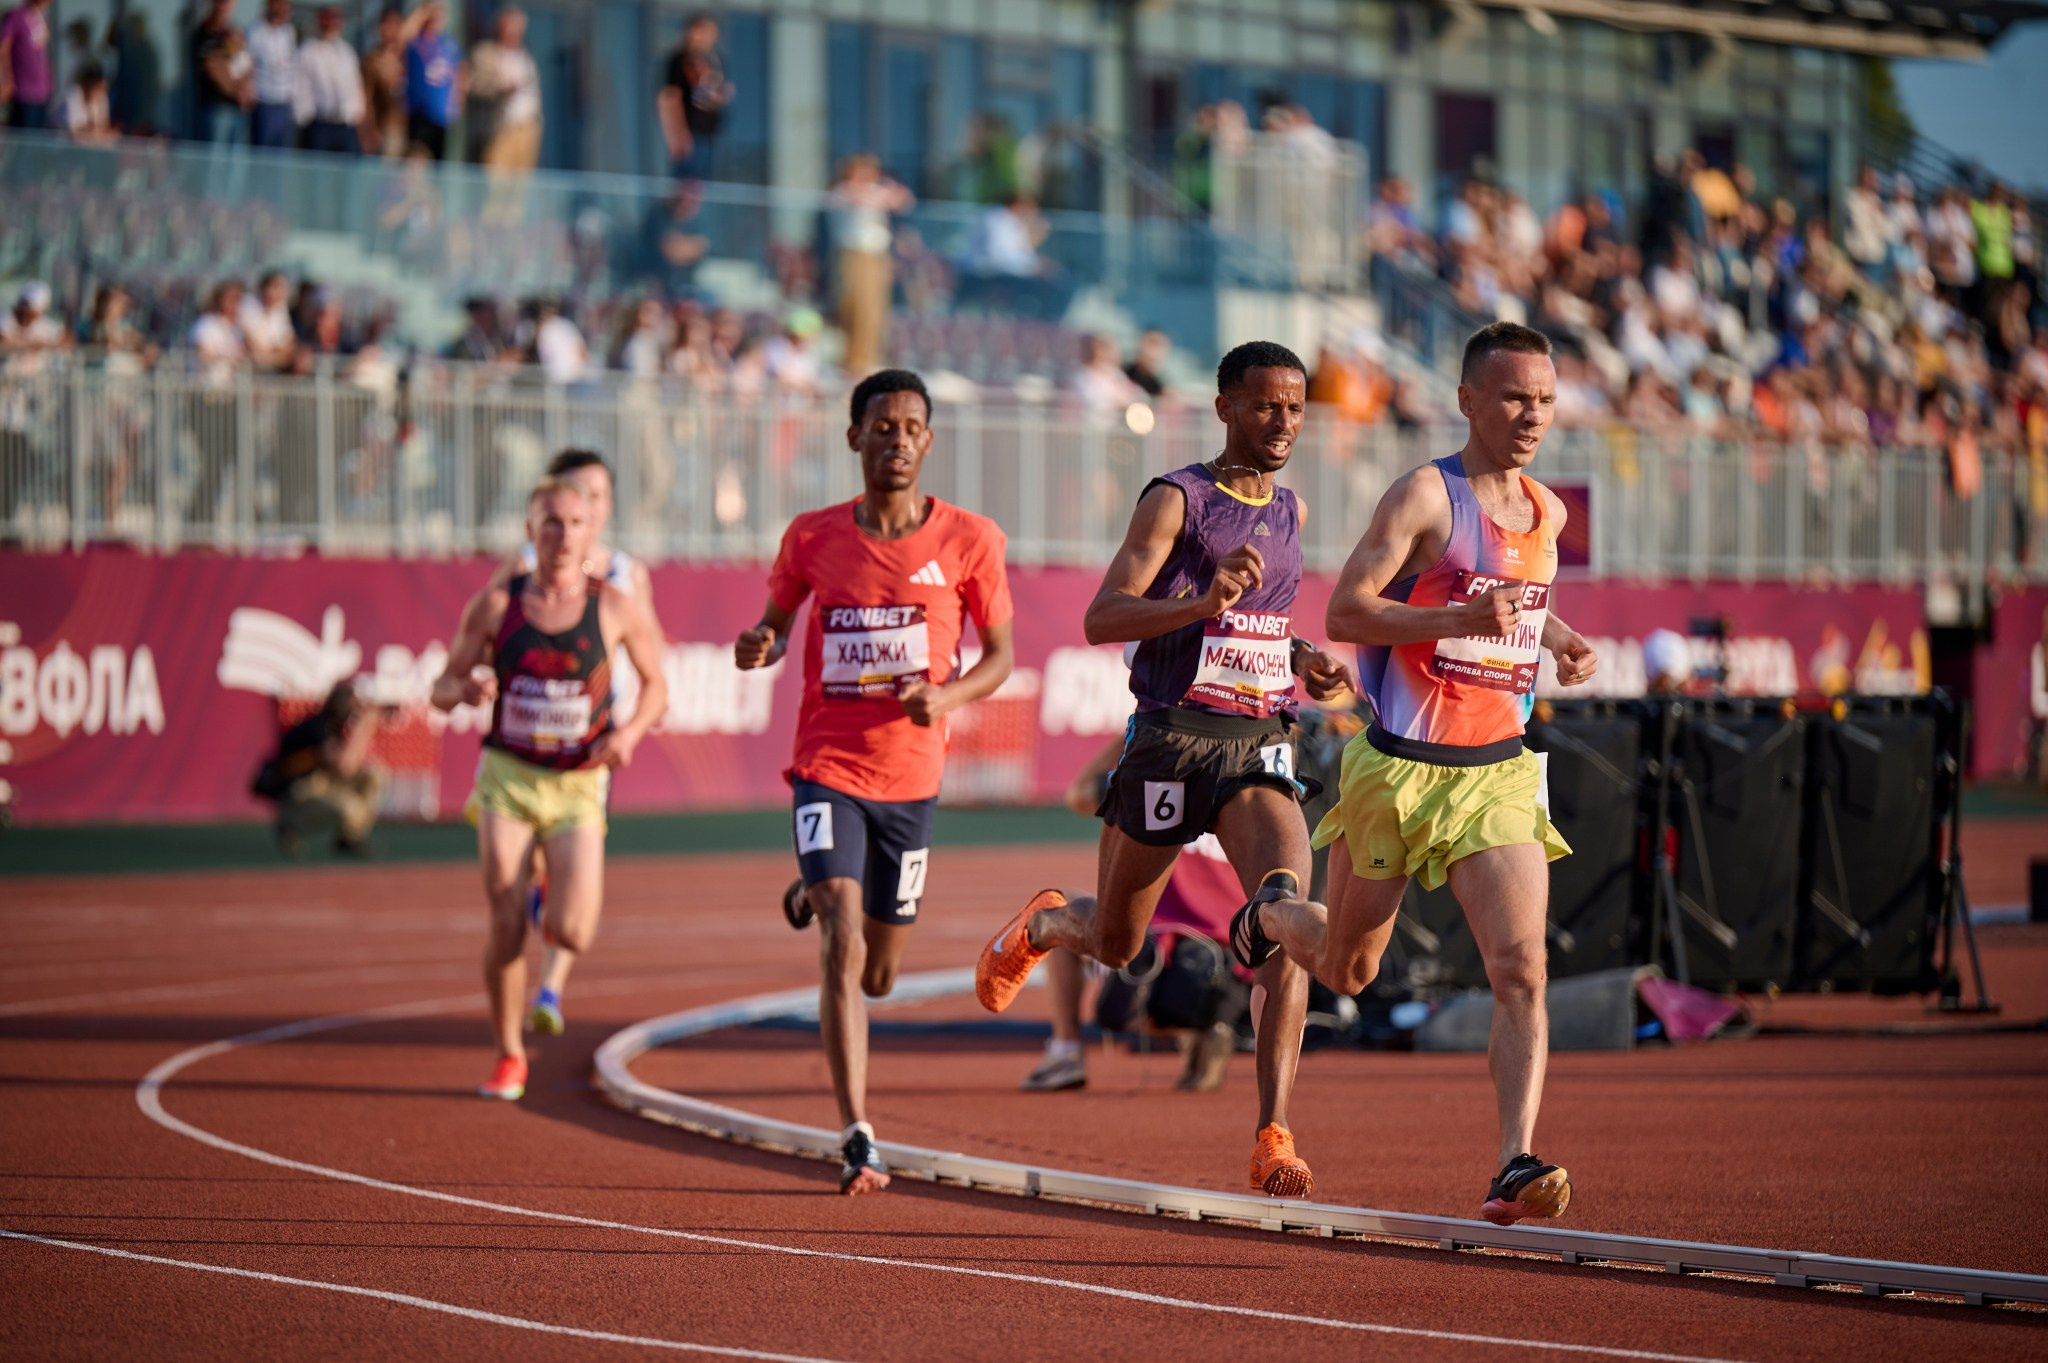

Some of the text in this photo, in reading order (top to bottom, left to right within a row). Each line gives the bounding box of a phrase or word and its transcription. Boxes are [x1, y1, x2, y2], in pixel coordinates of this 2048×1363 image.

[829, 606, 917, 628] FONBET
[1219, 609, 1290, 637] FONBET
[837, 641, 908, 669] ХАДЖИ
[1486, 658, 1511, 669] ФИНАЛ
[1438, 660, 1482, 677] КОРОЛЕВА
[1483, 669, 1513, 682] СПОРТА
[0, 640, 166, 739] ВФЛА
[1273, 747, 1287, 777] 6
[1154, 789, 1176, 821] 6
[803, 812, 822, 842] 7
[910, 860, 922, 890] 7
